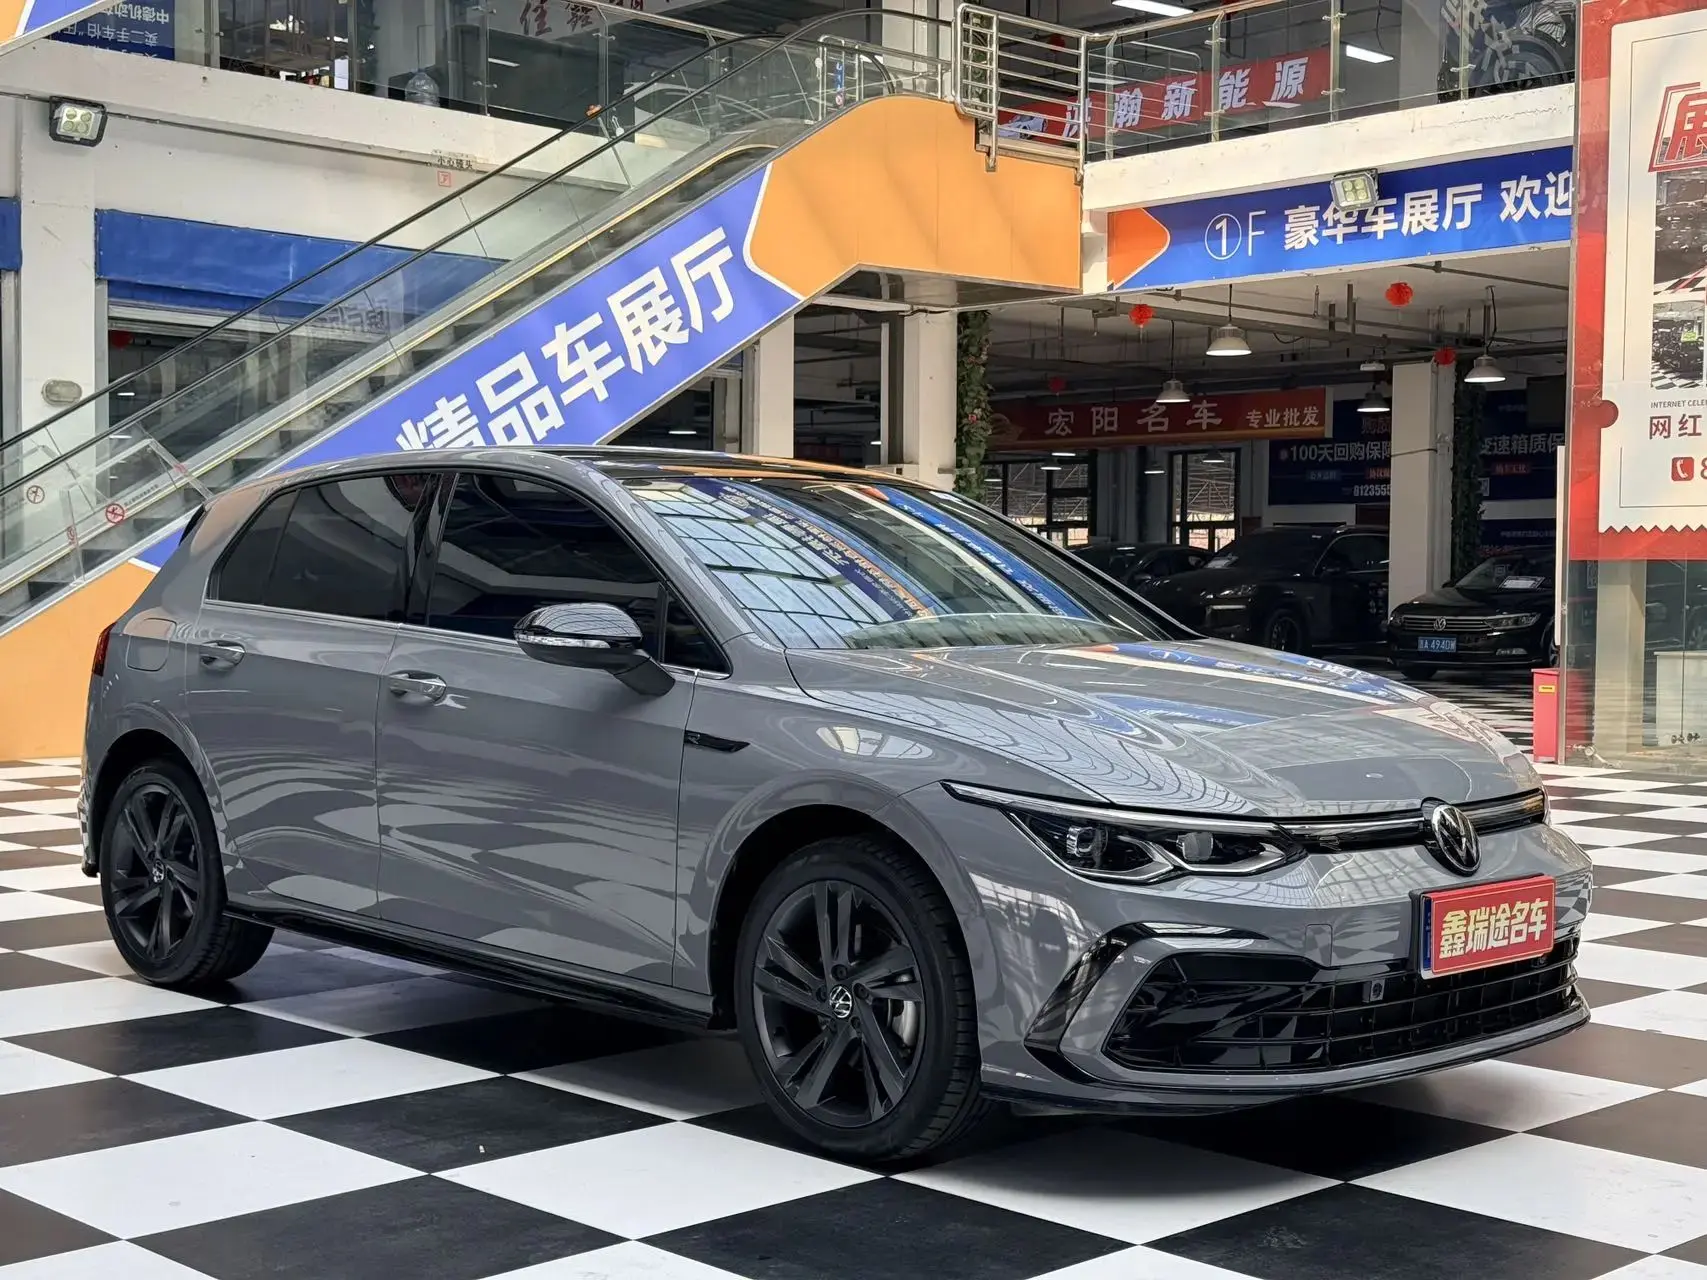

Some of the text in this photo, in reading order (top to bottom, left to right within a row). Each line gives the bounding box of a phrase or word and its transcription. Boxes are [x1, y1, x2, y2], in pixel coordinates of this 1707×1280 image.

[1284, 183, 1484, 252] 豪华车展厅
[396, 226, 736, 451] 精品车展厅
[1045, 400, 1320, 437] 宏阳名车 专业批发
[1649, 414, 1702, 440] 网红
[1650, 400, 1686, 409] INTERNET
[1439, 898, 1549, 959] 鑫瑞途名车
